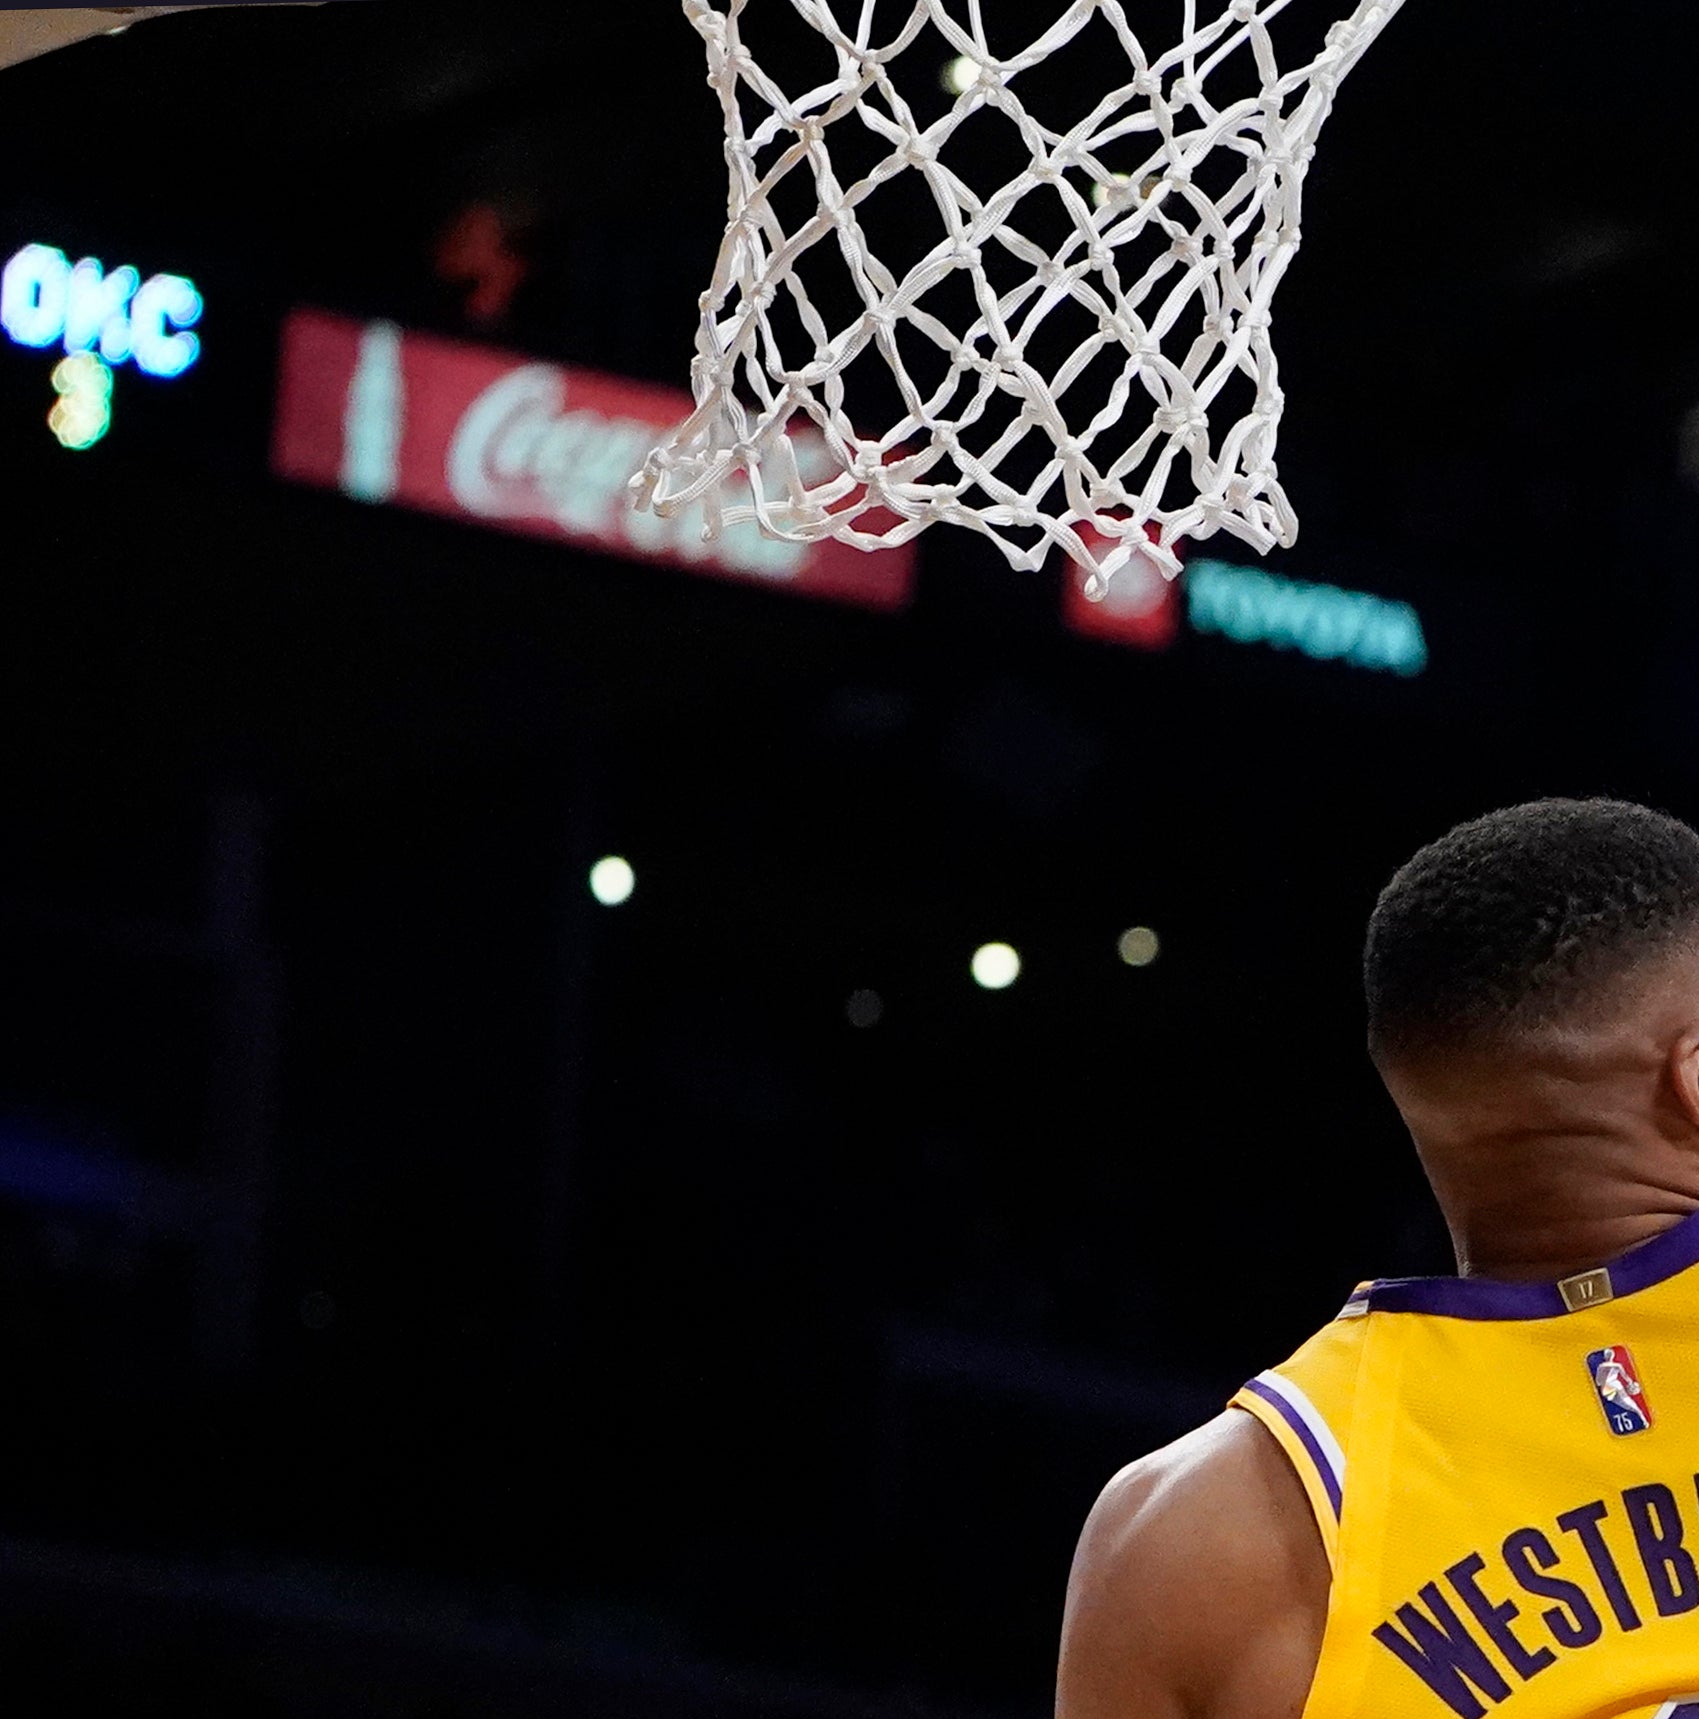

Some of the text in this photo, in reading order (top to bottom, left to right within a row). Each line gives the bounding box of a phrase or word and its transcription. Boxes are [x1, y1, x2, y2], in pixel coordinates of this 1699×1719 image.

[1, 243, 202, 376] OKC
[1189, 559, 1425, 673] TOYOTA
[1614, 1412, 1634, 1433] 75
